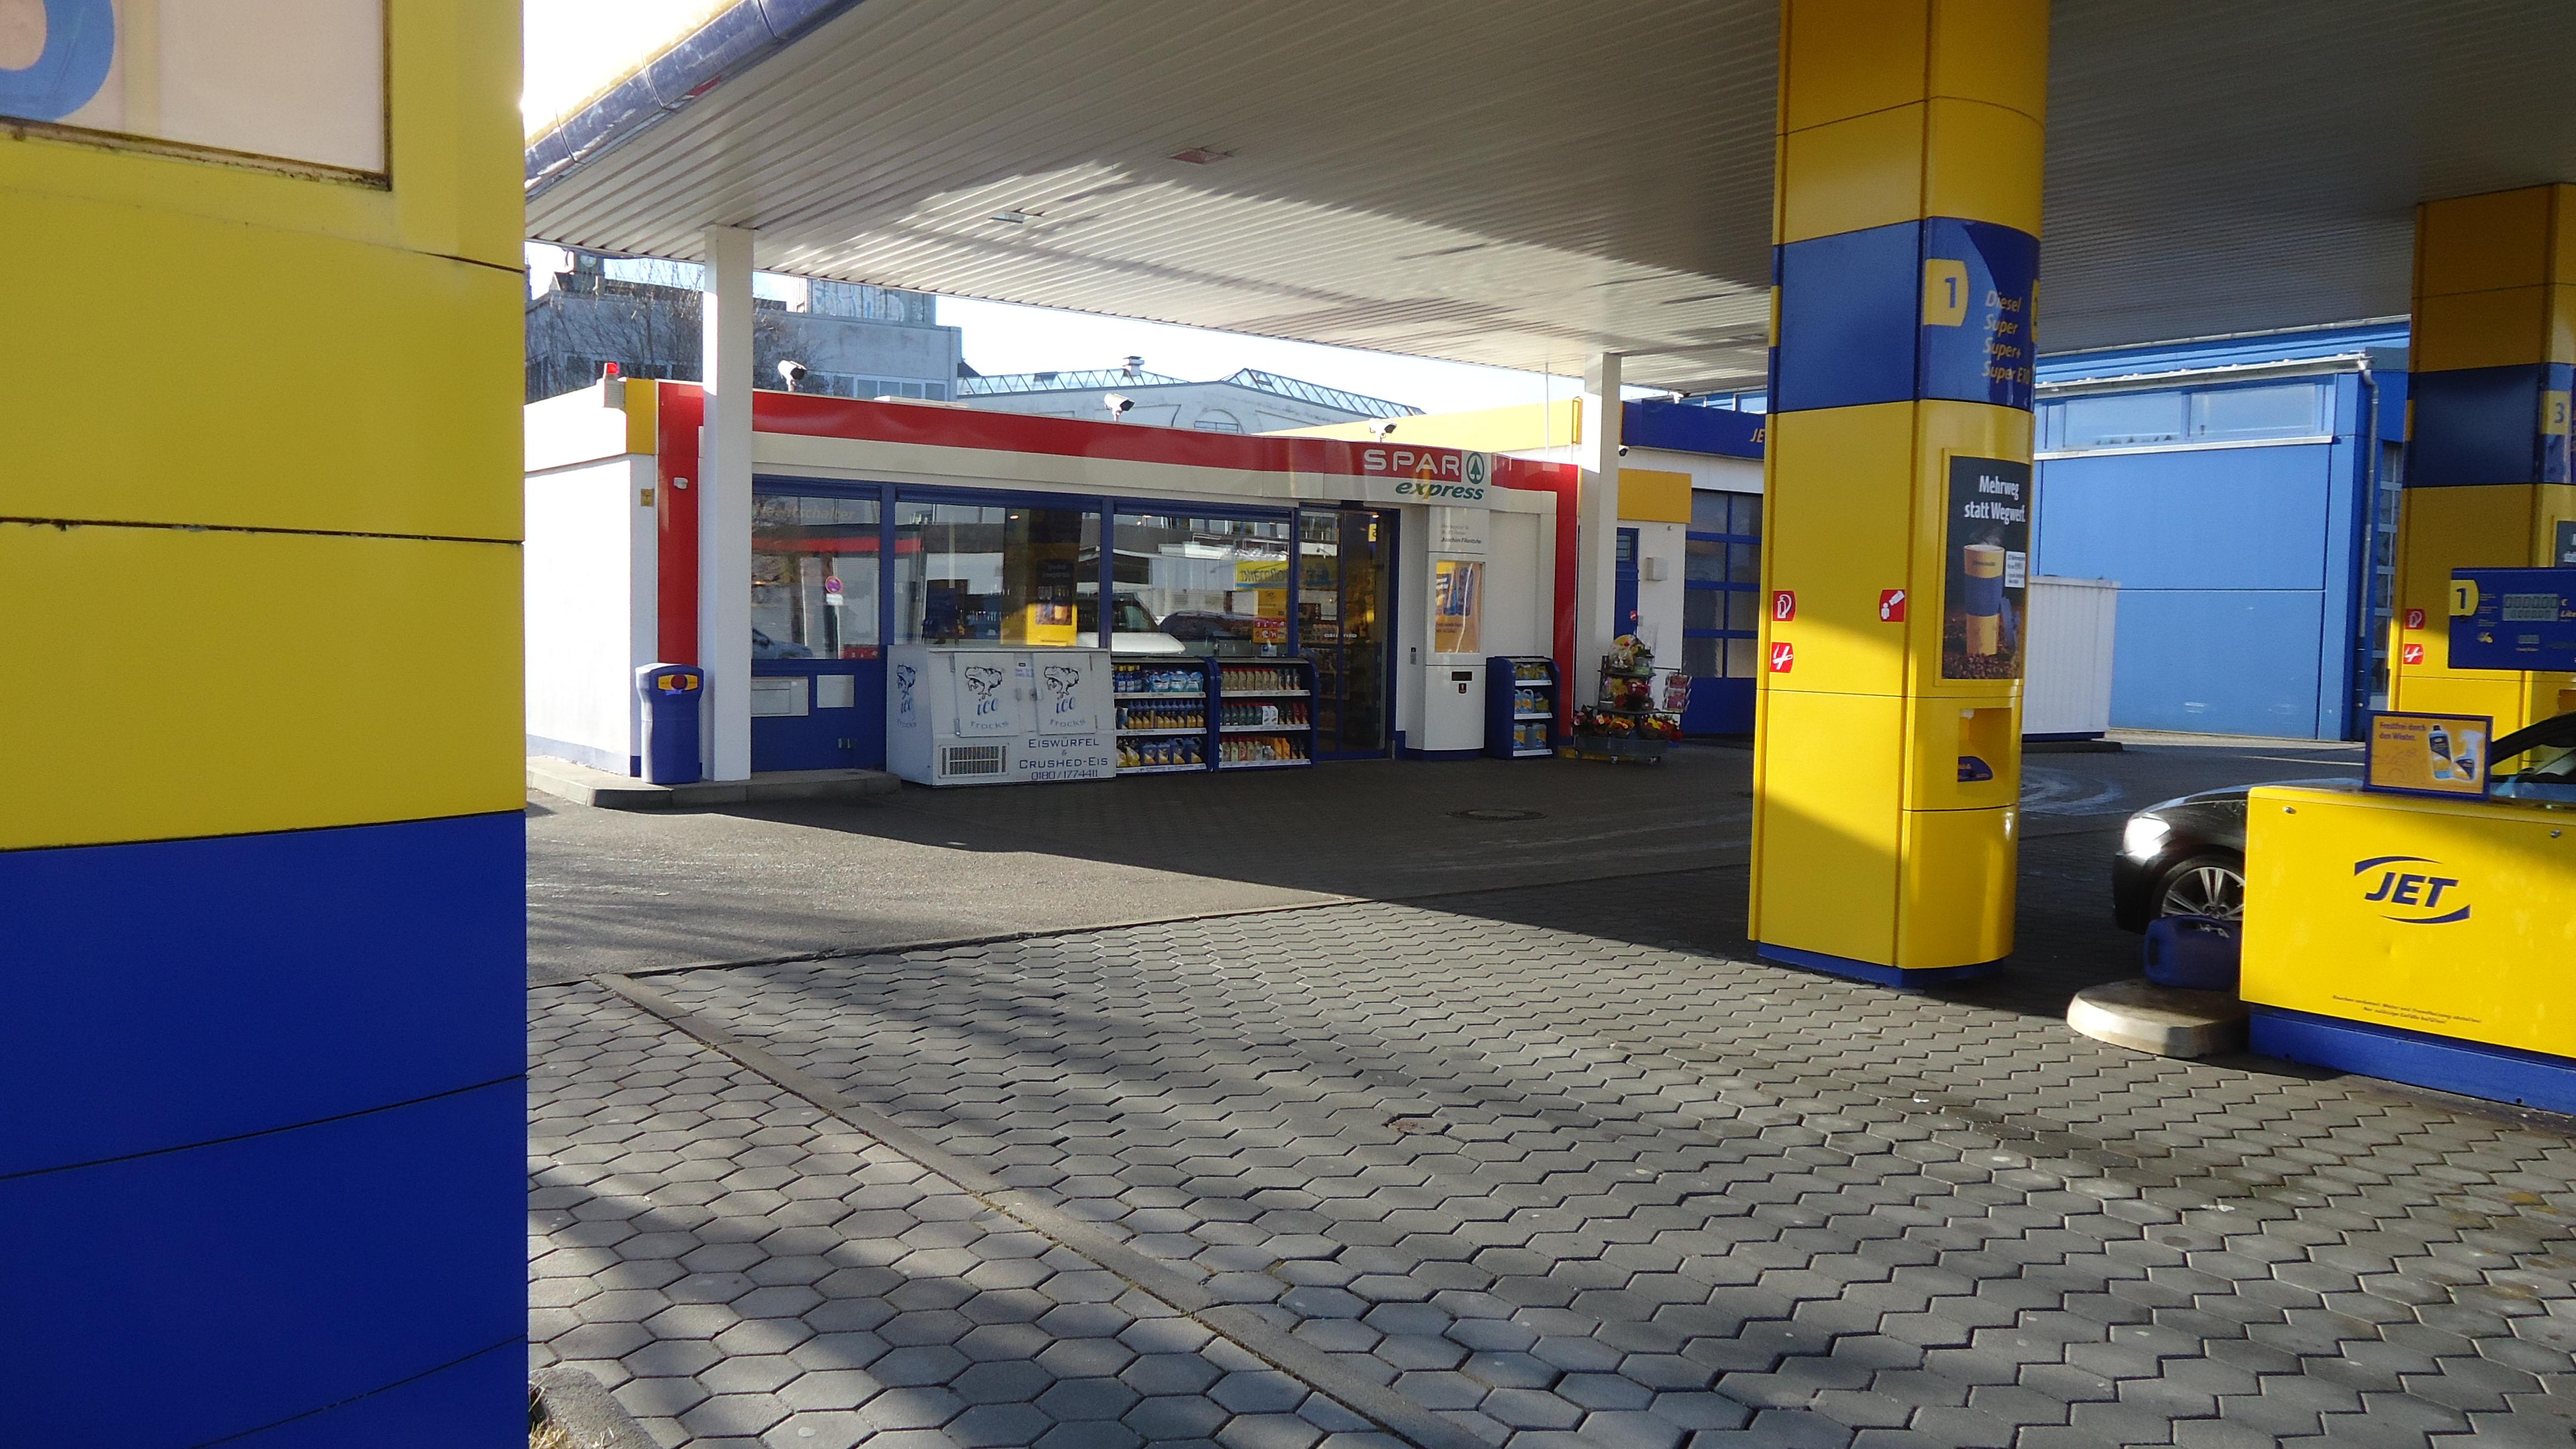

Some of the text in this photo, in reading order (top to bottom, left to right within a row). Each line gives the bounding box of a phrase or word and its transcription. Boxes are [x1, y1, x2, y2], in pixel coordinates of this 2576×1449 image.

[1945, 277, 1956, 308] 1
[1986, 290, 2021, 312] Diesel
[1983, 314, 2018, 336] Super
[1983, 337, 2021, 360] Super+
[1982, 361, 2015, 383] Super
[2555, 402, 2565, 423] 3
[1750, 428, 1766, 442] JE
[1364, 450, 1459, 476] SPAR
[1395, 482, 1484, 500] express
[1979, 475, 2019, 500] Mehrweg
[1964, 501, 1989, 519] statt
[2457, 588, 2467, 609] 1
[2364, 872, 2459, 908] JET
